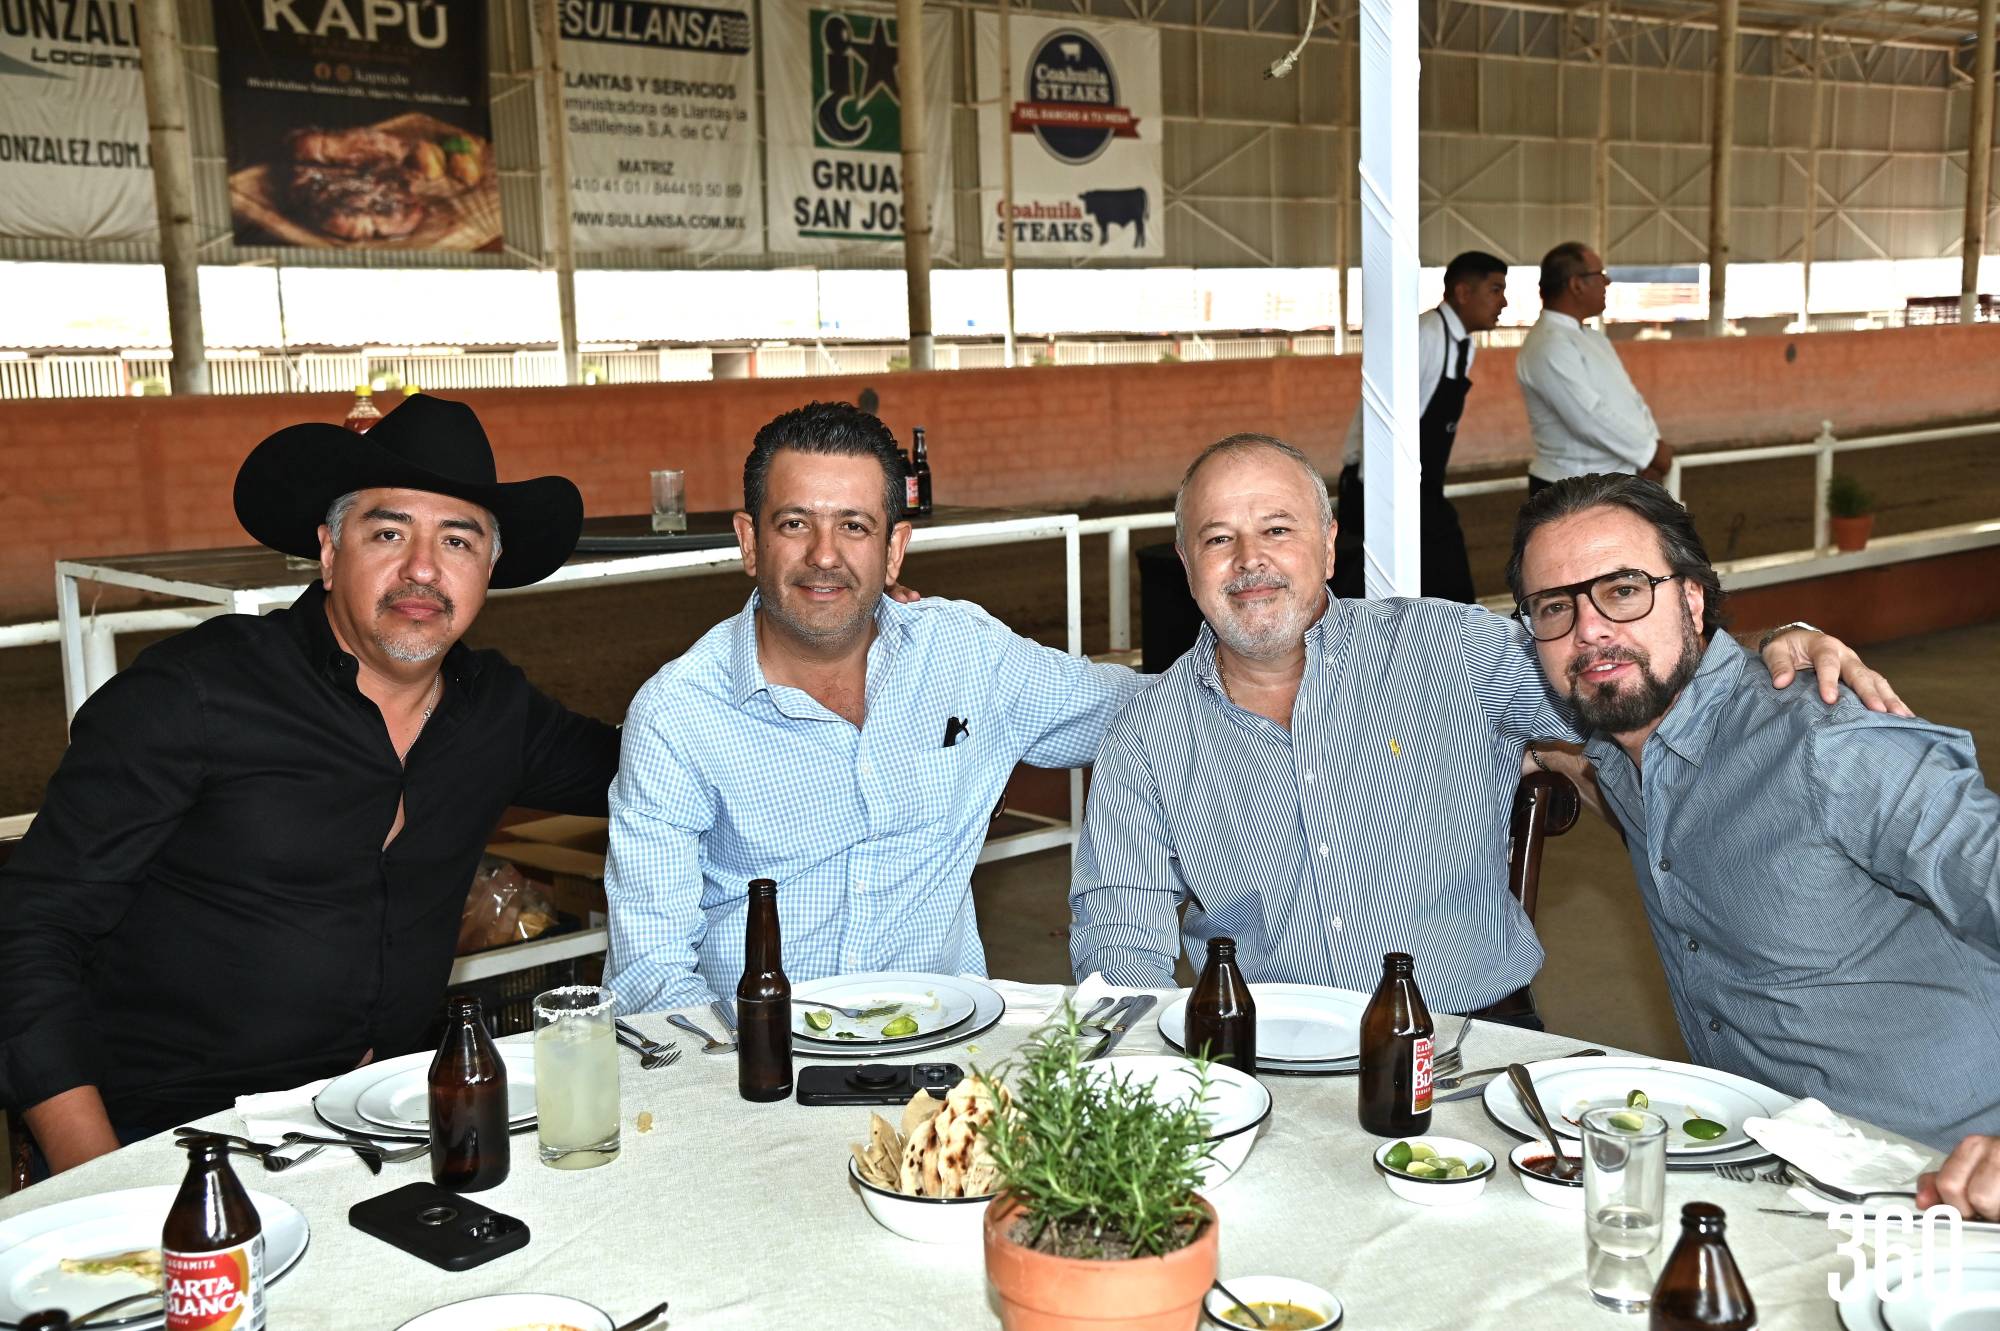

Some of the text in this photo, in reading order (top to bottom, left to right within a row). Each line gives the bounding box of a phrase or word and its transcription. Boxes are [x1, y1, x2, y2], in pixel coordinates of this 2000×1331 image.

[0, 0, 141, 47] ONZAL
[563, 0, 724, 48] SULLANSA
[565, 71, 737, 100] LANTAS Y SERVICIOS
[1036, 83, 1109, 103] STEAKS
[565, 96, 658, 116] ministradora
[661, 102, 680, 118] de
[680, 124, 698, 140] de
[0, 134, 152, 170] ONZALEZ.COM.
[618, 159, 675, 176] MATRIZ
[812, 159, 905, 195] GRUA
[794, 196, 932, 232] SAN JO
[166, 1275, 234, 1299] ARTA
